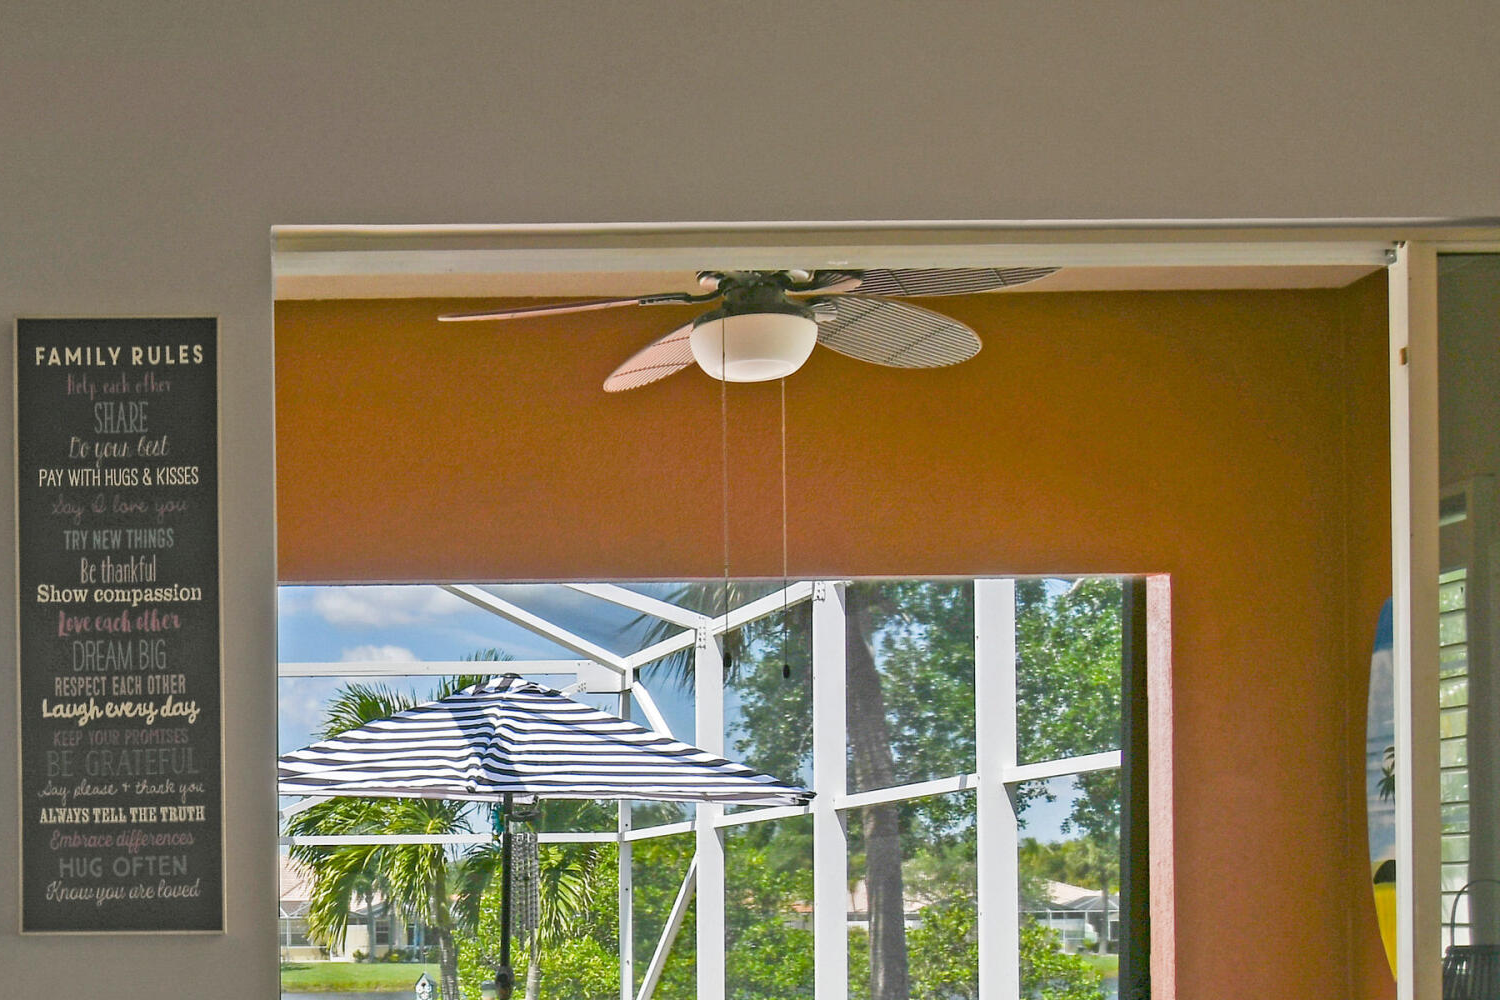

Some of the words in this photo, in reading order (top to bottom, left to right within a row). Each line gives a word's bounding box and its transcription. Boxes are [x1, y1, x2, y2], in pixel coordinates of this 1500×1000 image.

[36, 347, 120, 366] FAMILY
[132, 345, 203, 364] RULES
[68, 372, 97, 400] Help
[103, 373, 130, 394] each
[136, 372, 172, 393] other
[94, 402, 148, 434] SHARE
[69, 436, 89, 458] Do
[95, 440, 129, 468] your
[138, 435, 170, 457] best
[39, 470, 62, 486] PAY
[68, 469, 100, 486] WITH
[105, 468, 138, 486] HUGS
[143, 469, 152, 485] &
[157, 467, 199, 484] KISSES
[52, 495, 83, 524] Say
[112, 496, 148, 513] love
[155, 502, 188, 522] you
[64, 530, 88, 550] TRY
[92, 530, 122, 549] NEW
[126, 529, 174, 548] THINGS
[80, 558, 96, 583] Be
[101, 555, 156, 582] thankful
[37, 584, 88, 602] Show
[94, 584, 202, 607] compassion
[59, 610, 91, 637] Love
[96, 610, 130, 633] each
[135, 608, 181, 632] other
[73, 640, 132, 672] DREAM
[139, 640, 166, 669] BIG
[55, 677, 106, 696] RESPECT
[112, 676, 142, 695] EACH
[148, 674, 186, 694] OTHER
[42, 699, 103, 726] Laugh
[104, 700, 158, 724] every
[160, 696, 200, 723] day
[54, 730, 82, 746] KEEP
[89, 730, 120, 745] YOUR
[124, 728, 188, 744] PROMISES
[47, 751, 75, 777] BE
[85, 748, 199, 776] GRATEFUL
[38, 780, 69, 805] Say
[74, 780, 118, 798] please
[135, 779, 175, 794] thank
[179, 782, 205, 803] you
[40, 807, 89, 823] ALWAYS
[93, 808, 126, 822] TELL
[130, 806, 156, 822] THE
[160, 806, 205, 821] TRUTH
[50, 831, 113, 850] Embrace
[116, 829, 194, 856] differences
[60, 858, 103, 878] HUG
[113, 856, 187, 876] OFTEN
[46, 880, 93, 900] Know
[96, 887, 126, 905] you
[129, 887, 154, 898] are
[158, 879, 201, 898] loved
